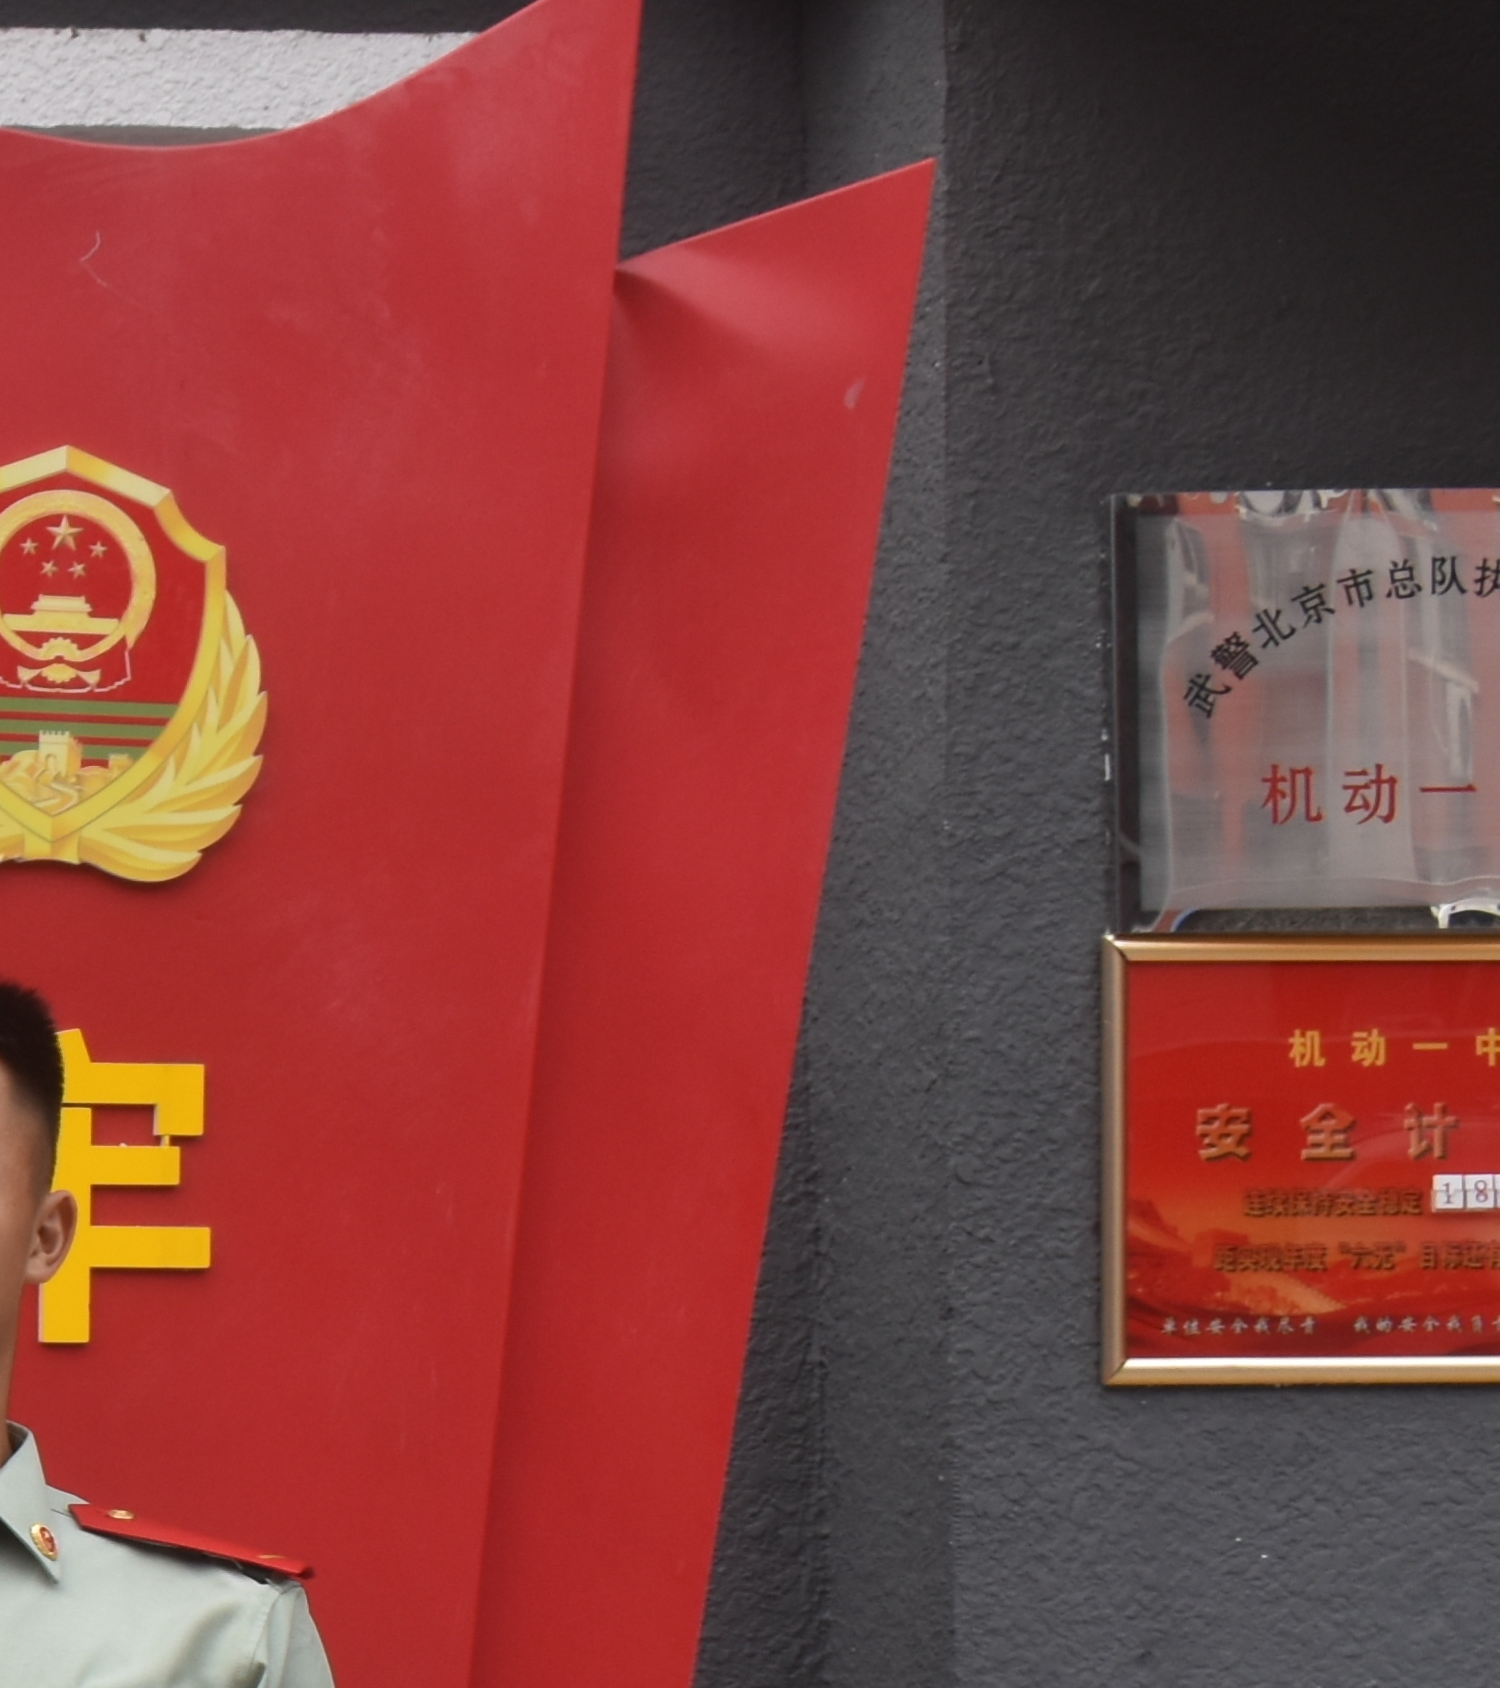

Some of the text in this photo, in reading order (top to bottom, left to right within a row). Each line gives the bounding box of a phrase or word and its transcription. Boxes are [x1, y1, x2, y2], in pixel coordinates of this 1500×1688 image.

[1261, 763, 1477, 826] 机动一
[1196, 1102, 1458, 1161] 安全计
